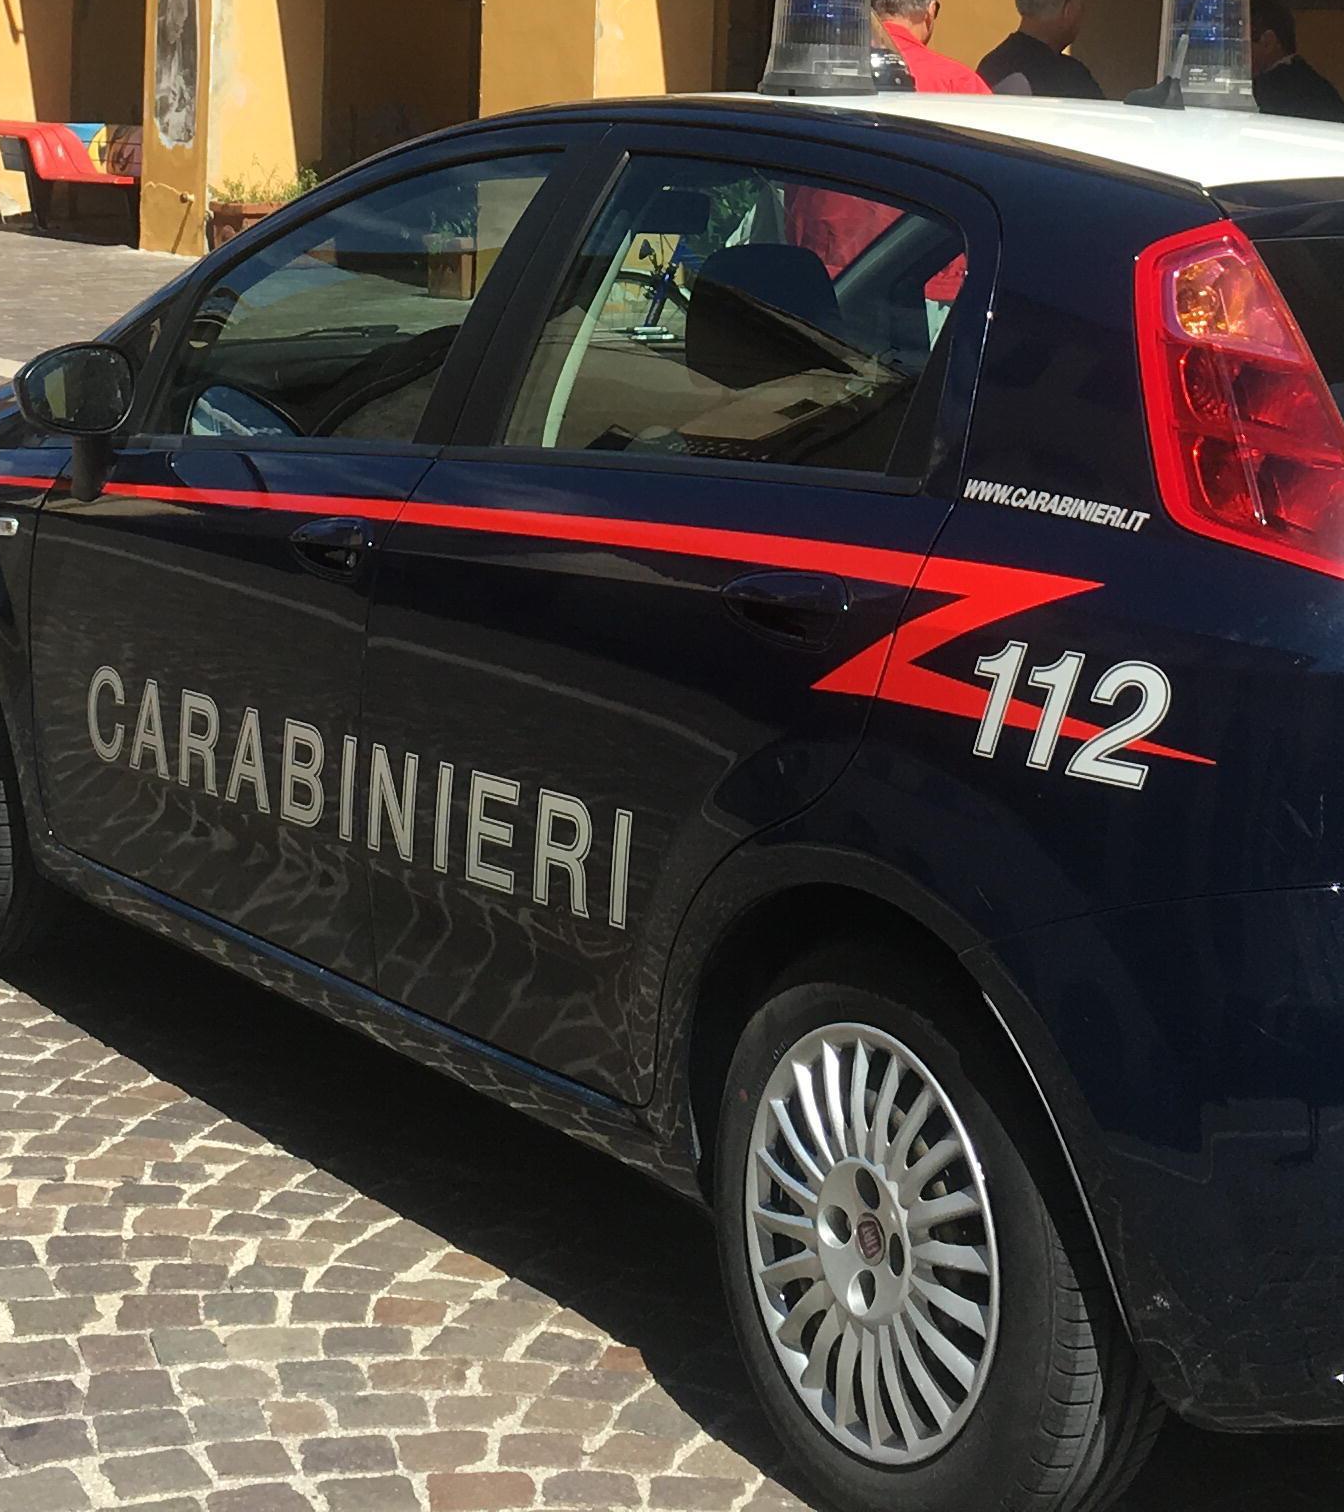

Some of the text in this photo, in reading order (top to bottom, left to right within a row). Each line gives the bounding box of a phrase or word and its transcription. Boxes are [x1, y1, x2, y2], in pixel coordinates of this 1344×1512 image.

[963, 478, 1150, 532] WWW.CARABINIERI.IT
[971, 640, 1172, 791] 112
[87, 664, 633, 930] CARABINIERI
